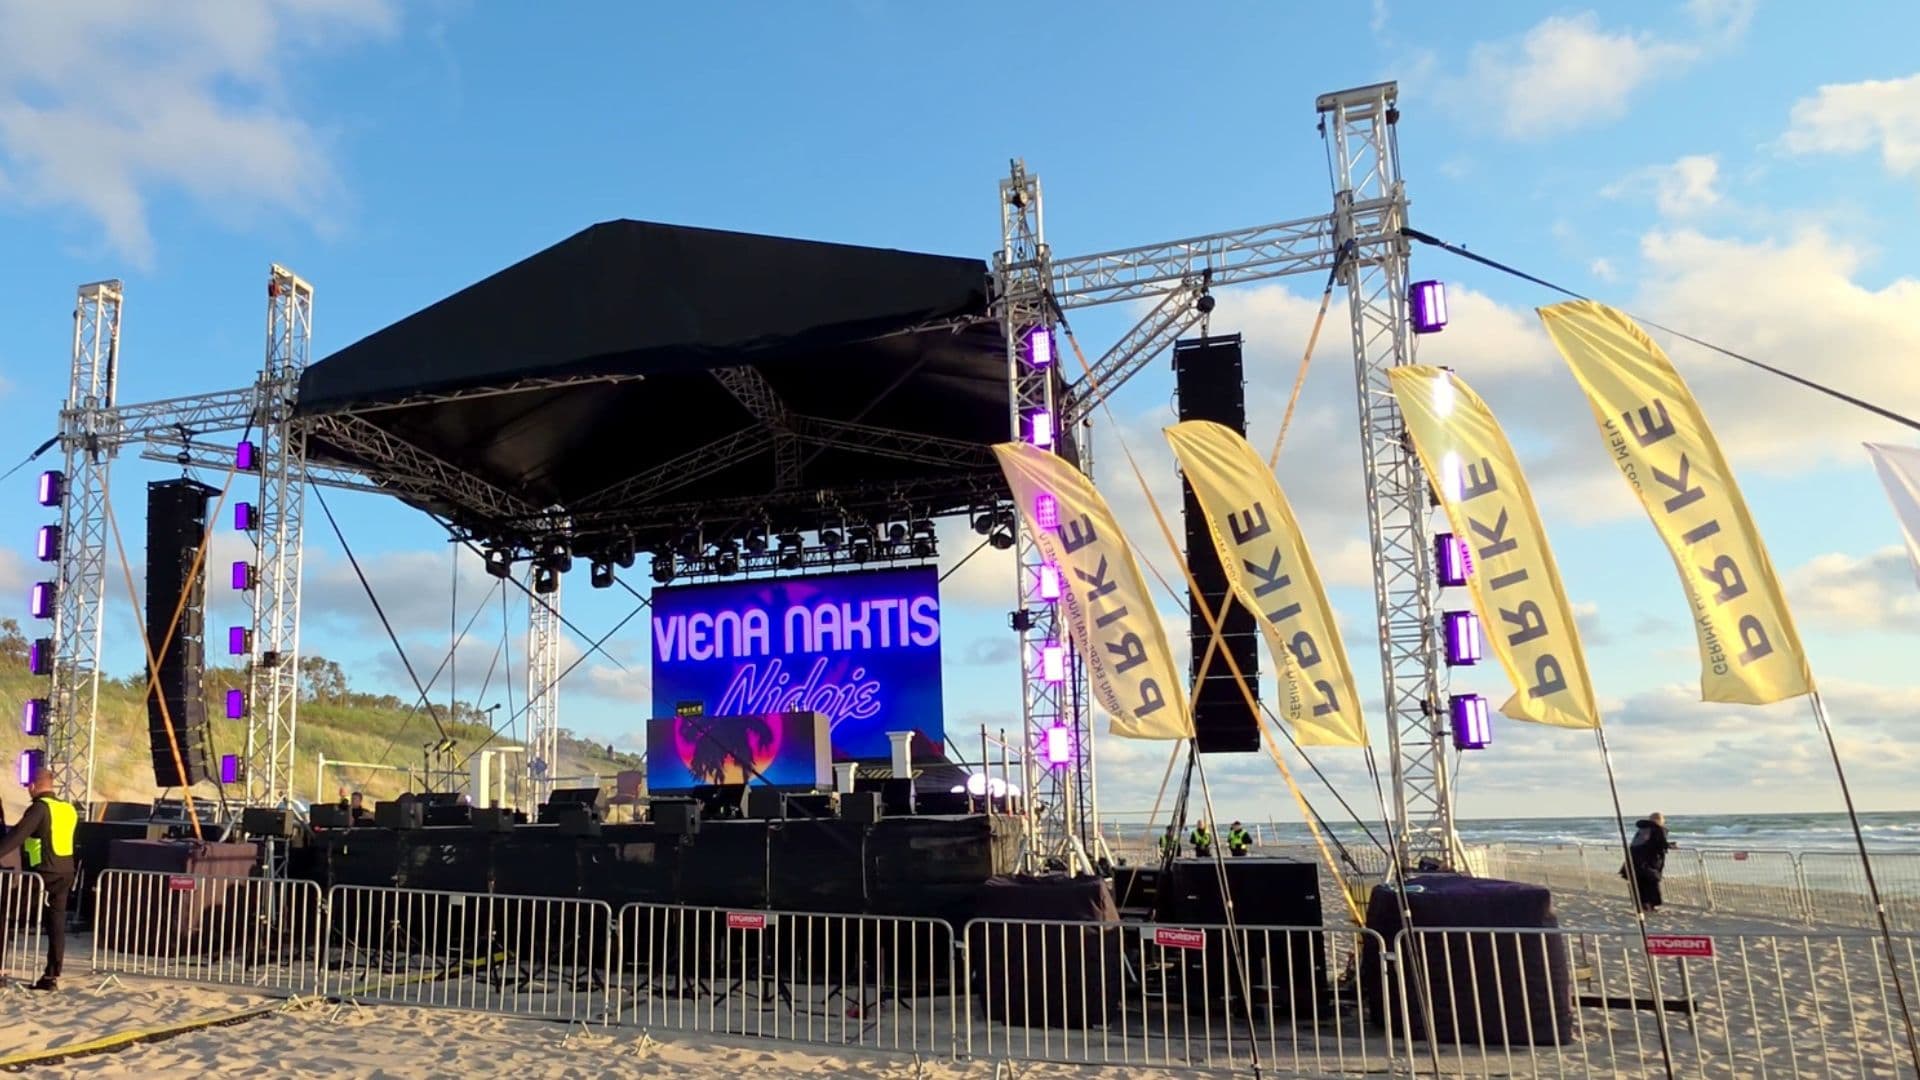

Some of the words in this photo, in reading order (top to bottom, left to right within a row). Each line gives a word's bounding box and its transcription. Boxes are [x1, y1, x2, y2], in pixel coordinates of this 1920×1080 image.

[654, 608, 769, 662] VIENA
[784, 596, 939, 654] NAKTIS
[714, 657, 880, 733] Nidoje
[1158, 931, 1200, 942] STORENT
[1647, 939, 1707, 949] STORENT
